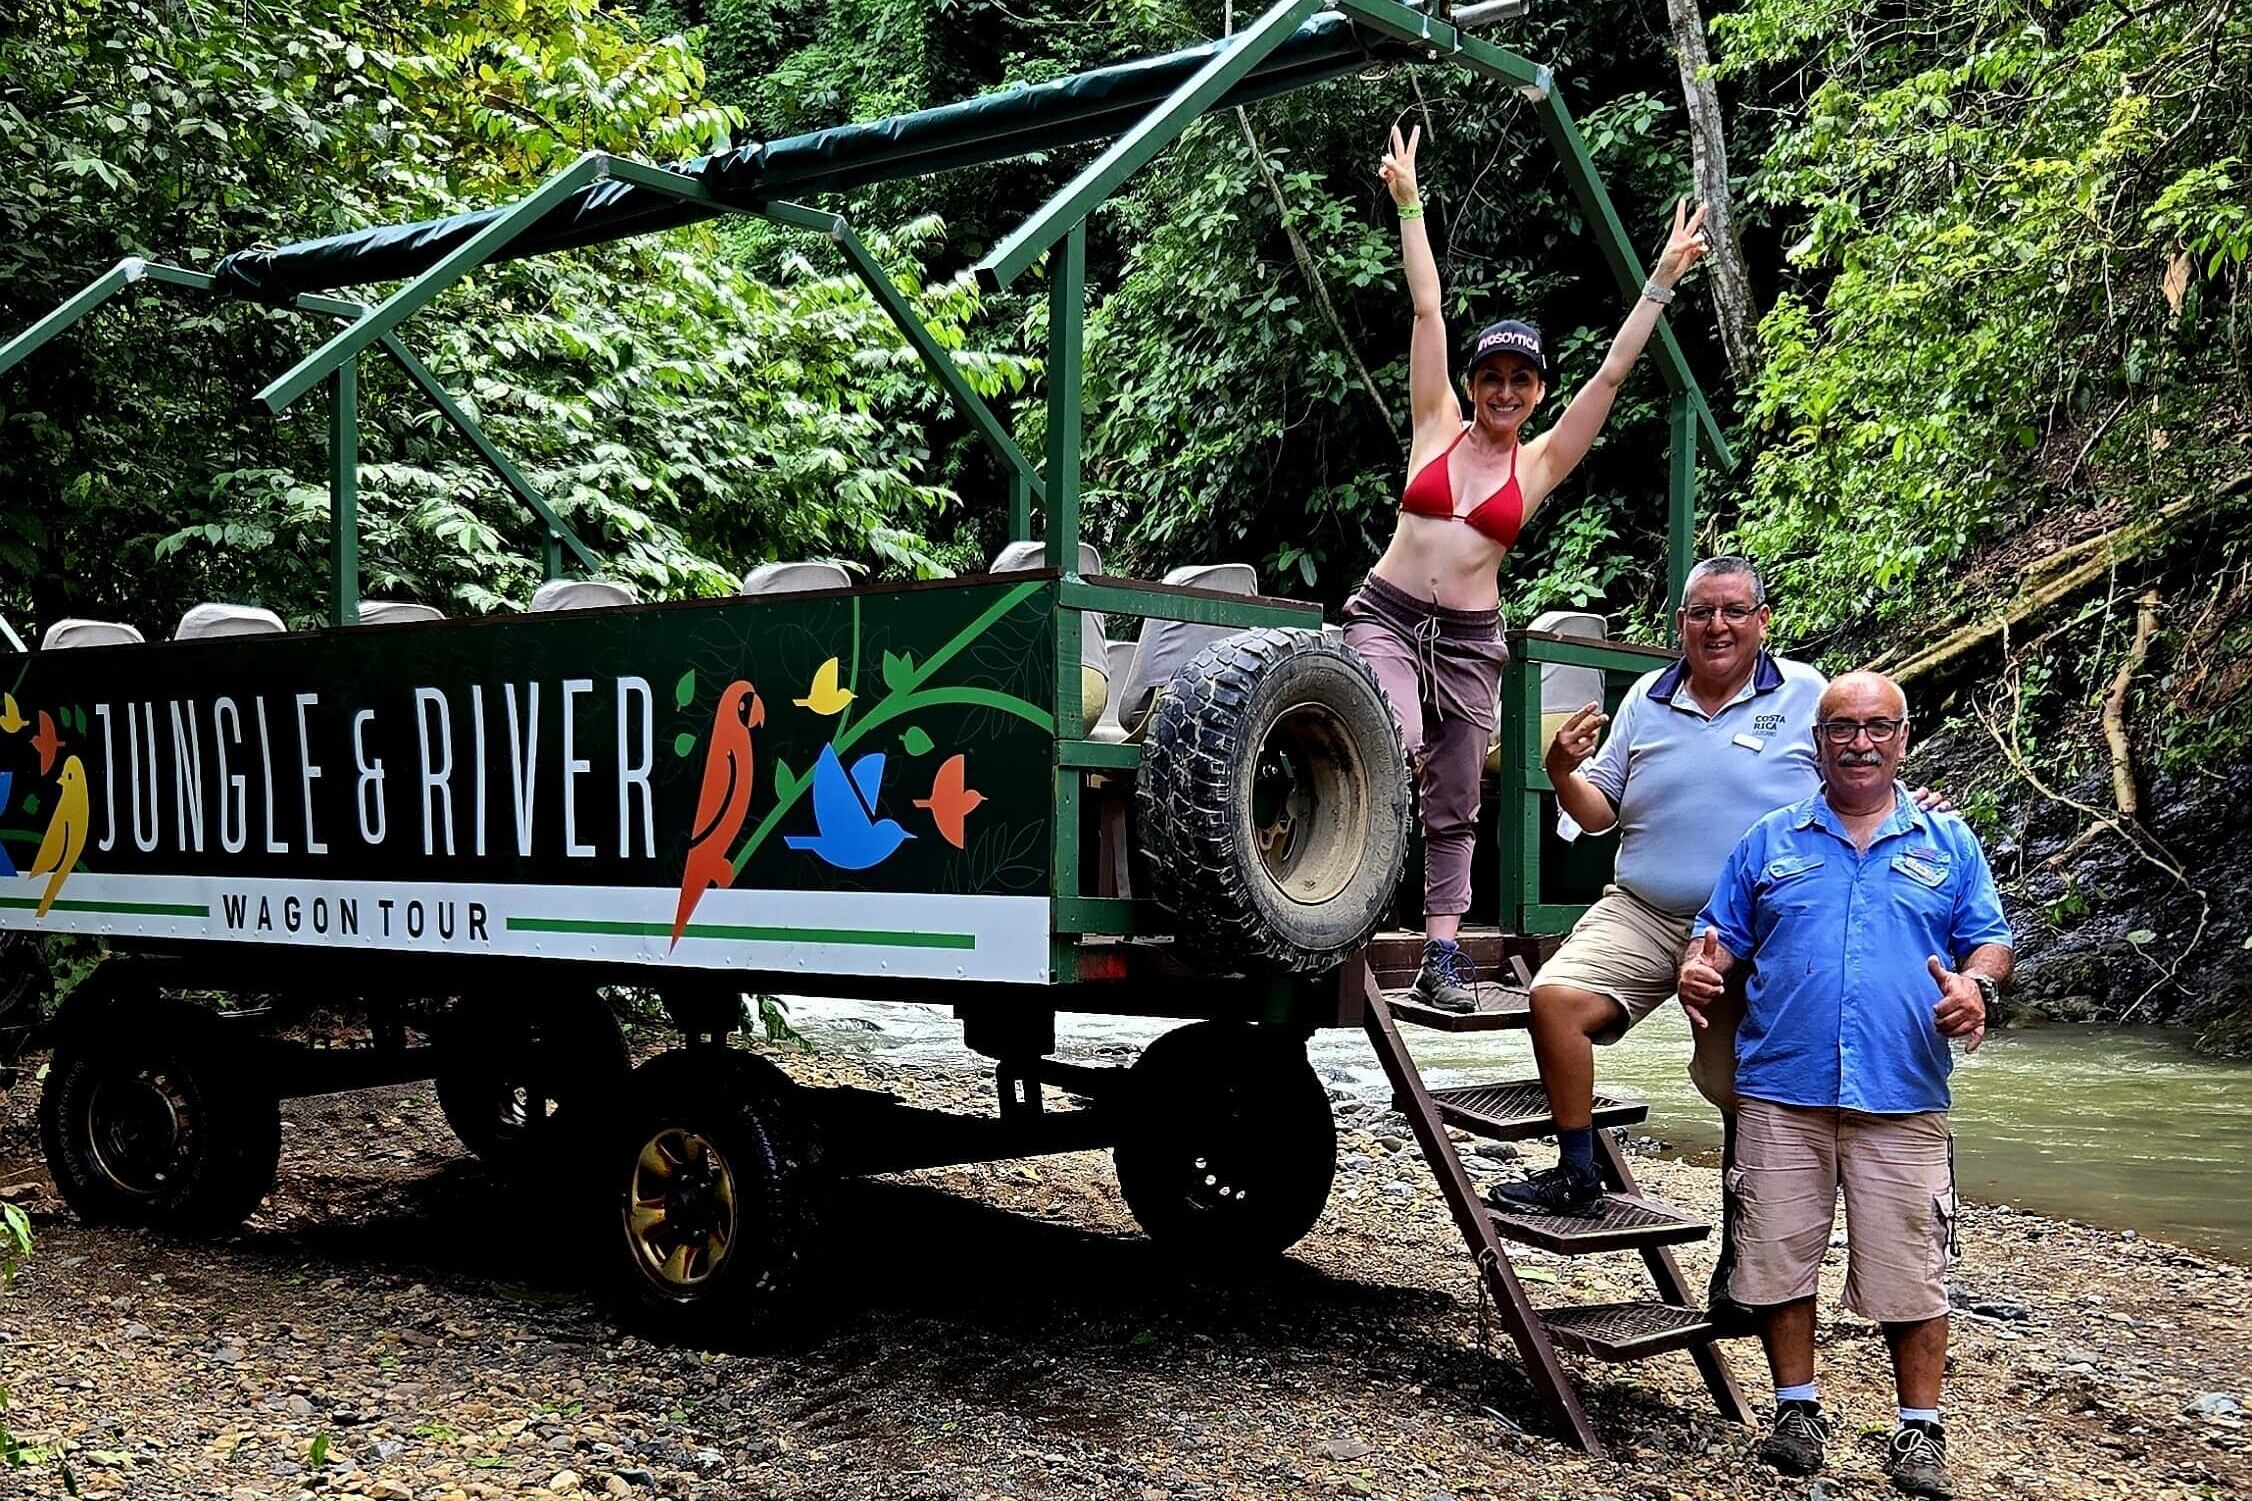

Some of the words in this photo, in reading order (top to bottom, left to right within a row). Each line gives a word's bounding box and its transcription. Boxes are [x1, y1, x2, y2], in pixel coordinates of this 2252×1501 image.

[1753, 722, 1777, 730] RICA
[1755, 714, 1786, 723] COSTA
[96, 694, 328, 854] JUNGLE
[354, 710, 385, 844] &
[416, 677, 655, 858] RIVER
[223, 895, 358, 934] WAGON
[379, 900, 488, 940] TOUR
